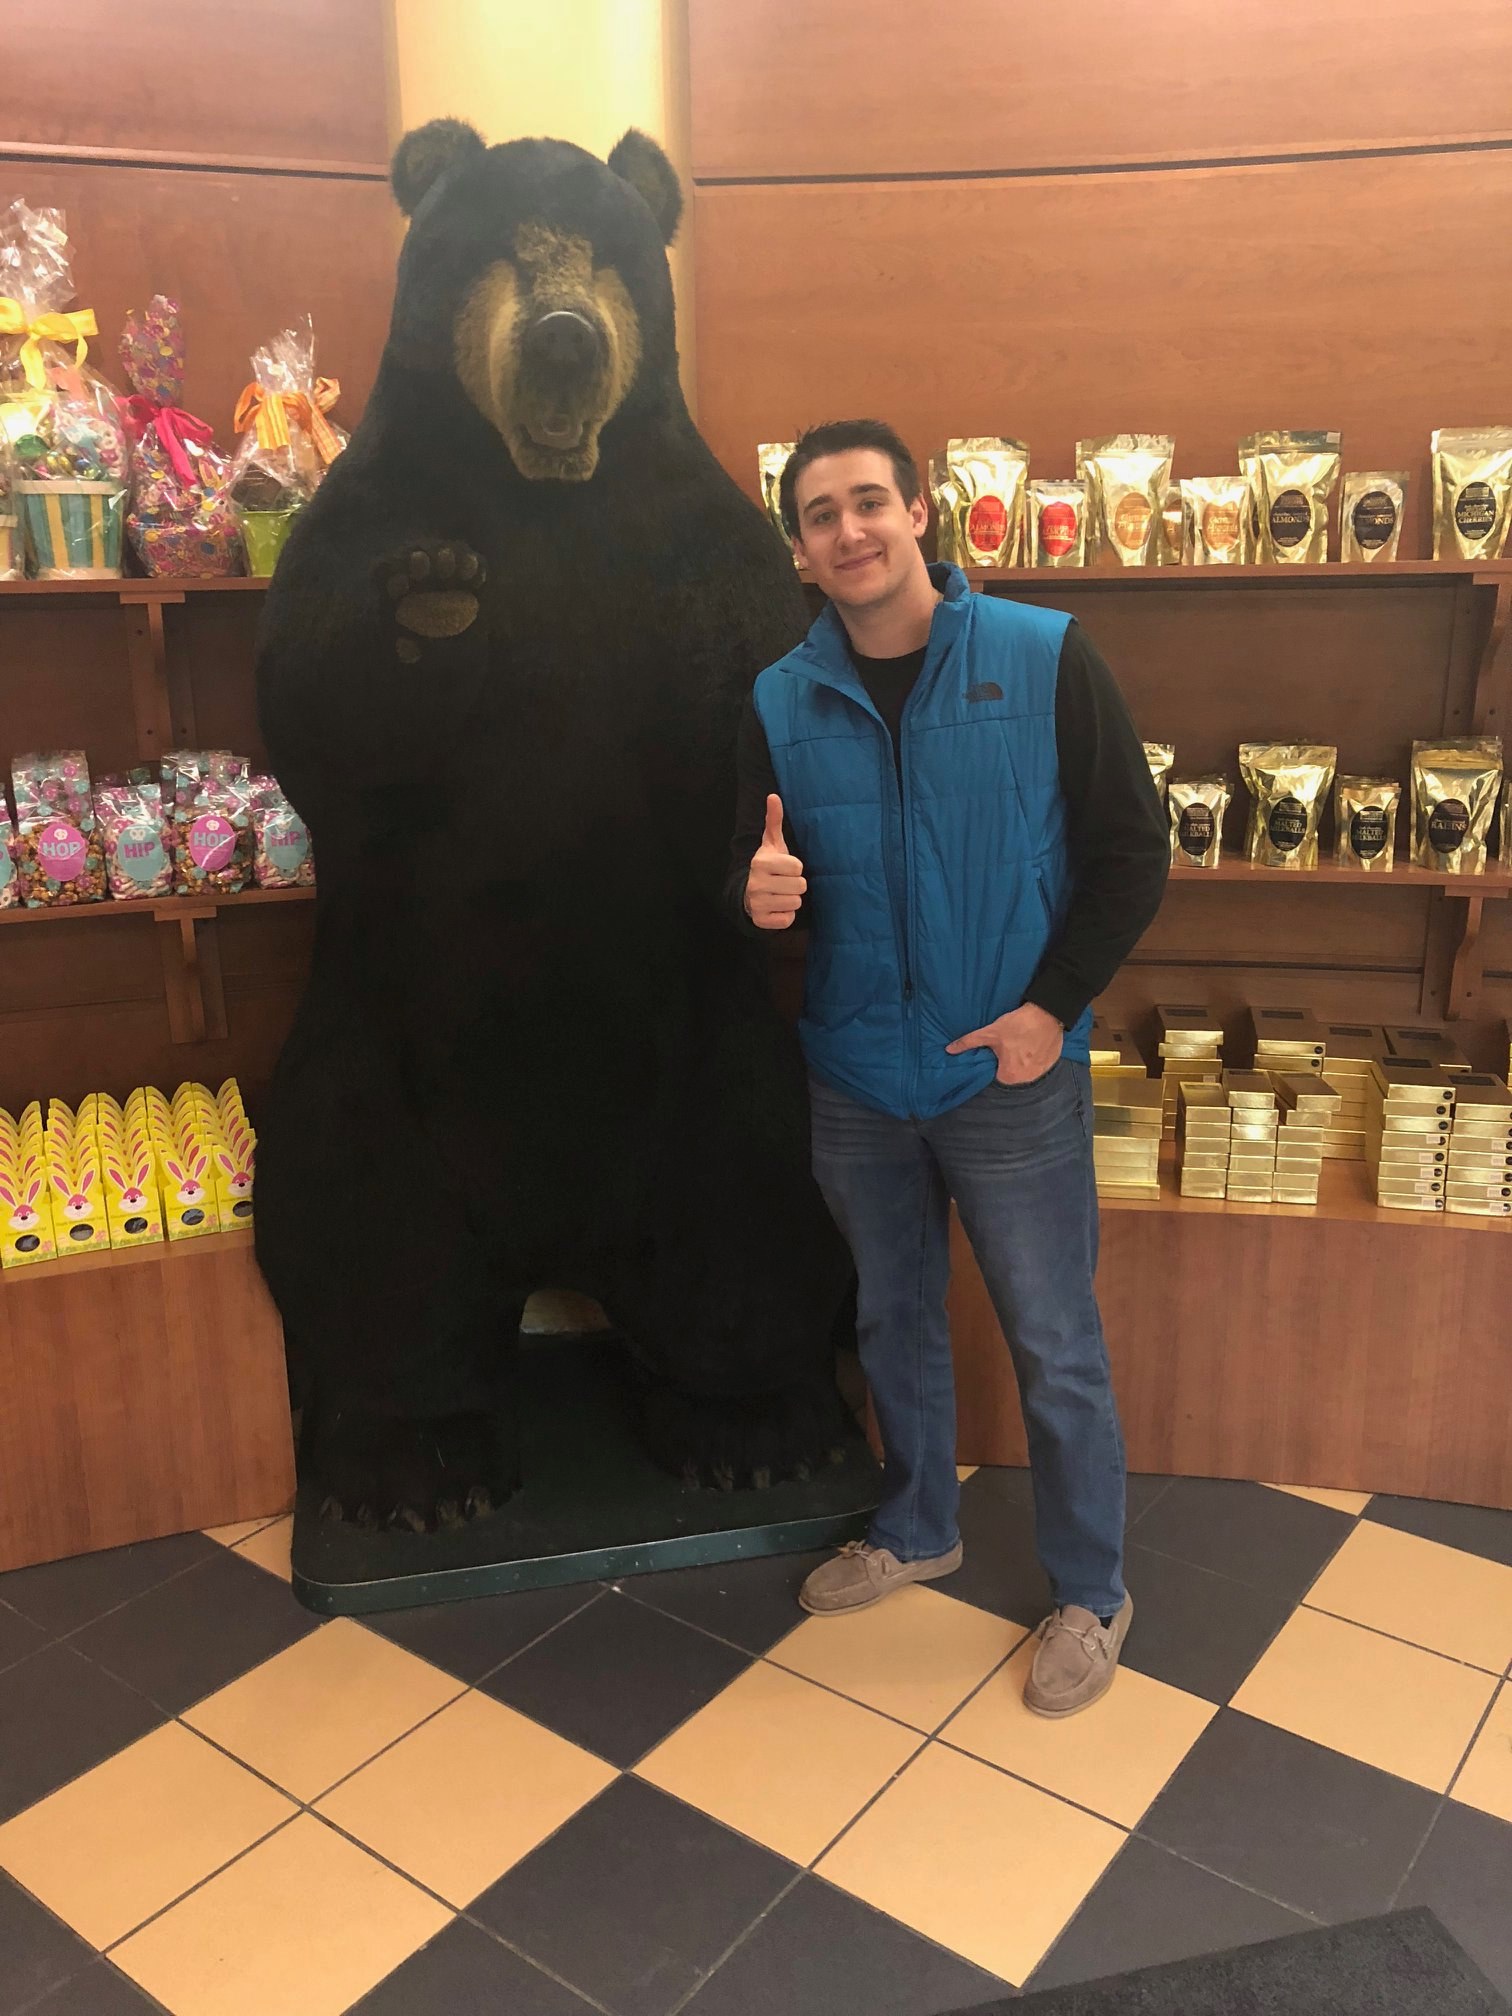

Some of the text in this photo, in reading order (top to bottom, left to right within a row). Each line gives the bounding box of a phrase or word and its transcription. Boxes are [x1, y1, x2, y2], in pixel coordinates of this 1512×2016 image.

[1272, 515, 1310, 524] ALMONDS
[1457, 510, 1495, 518] MICHIGAN
[193, 832, 230, 847] HOP
[270, 831, 301, 847] HIP
[42, 841, 81, 857] HOP
[123, 841, 156, 858] HIP
